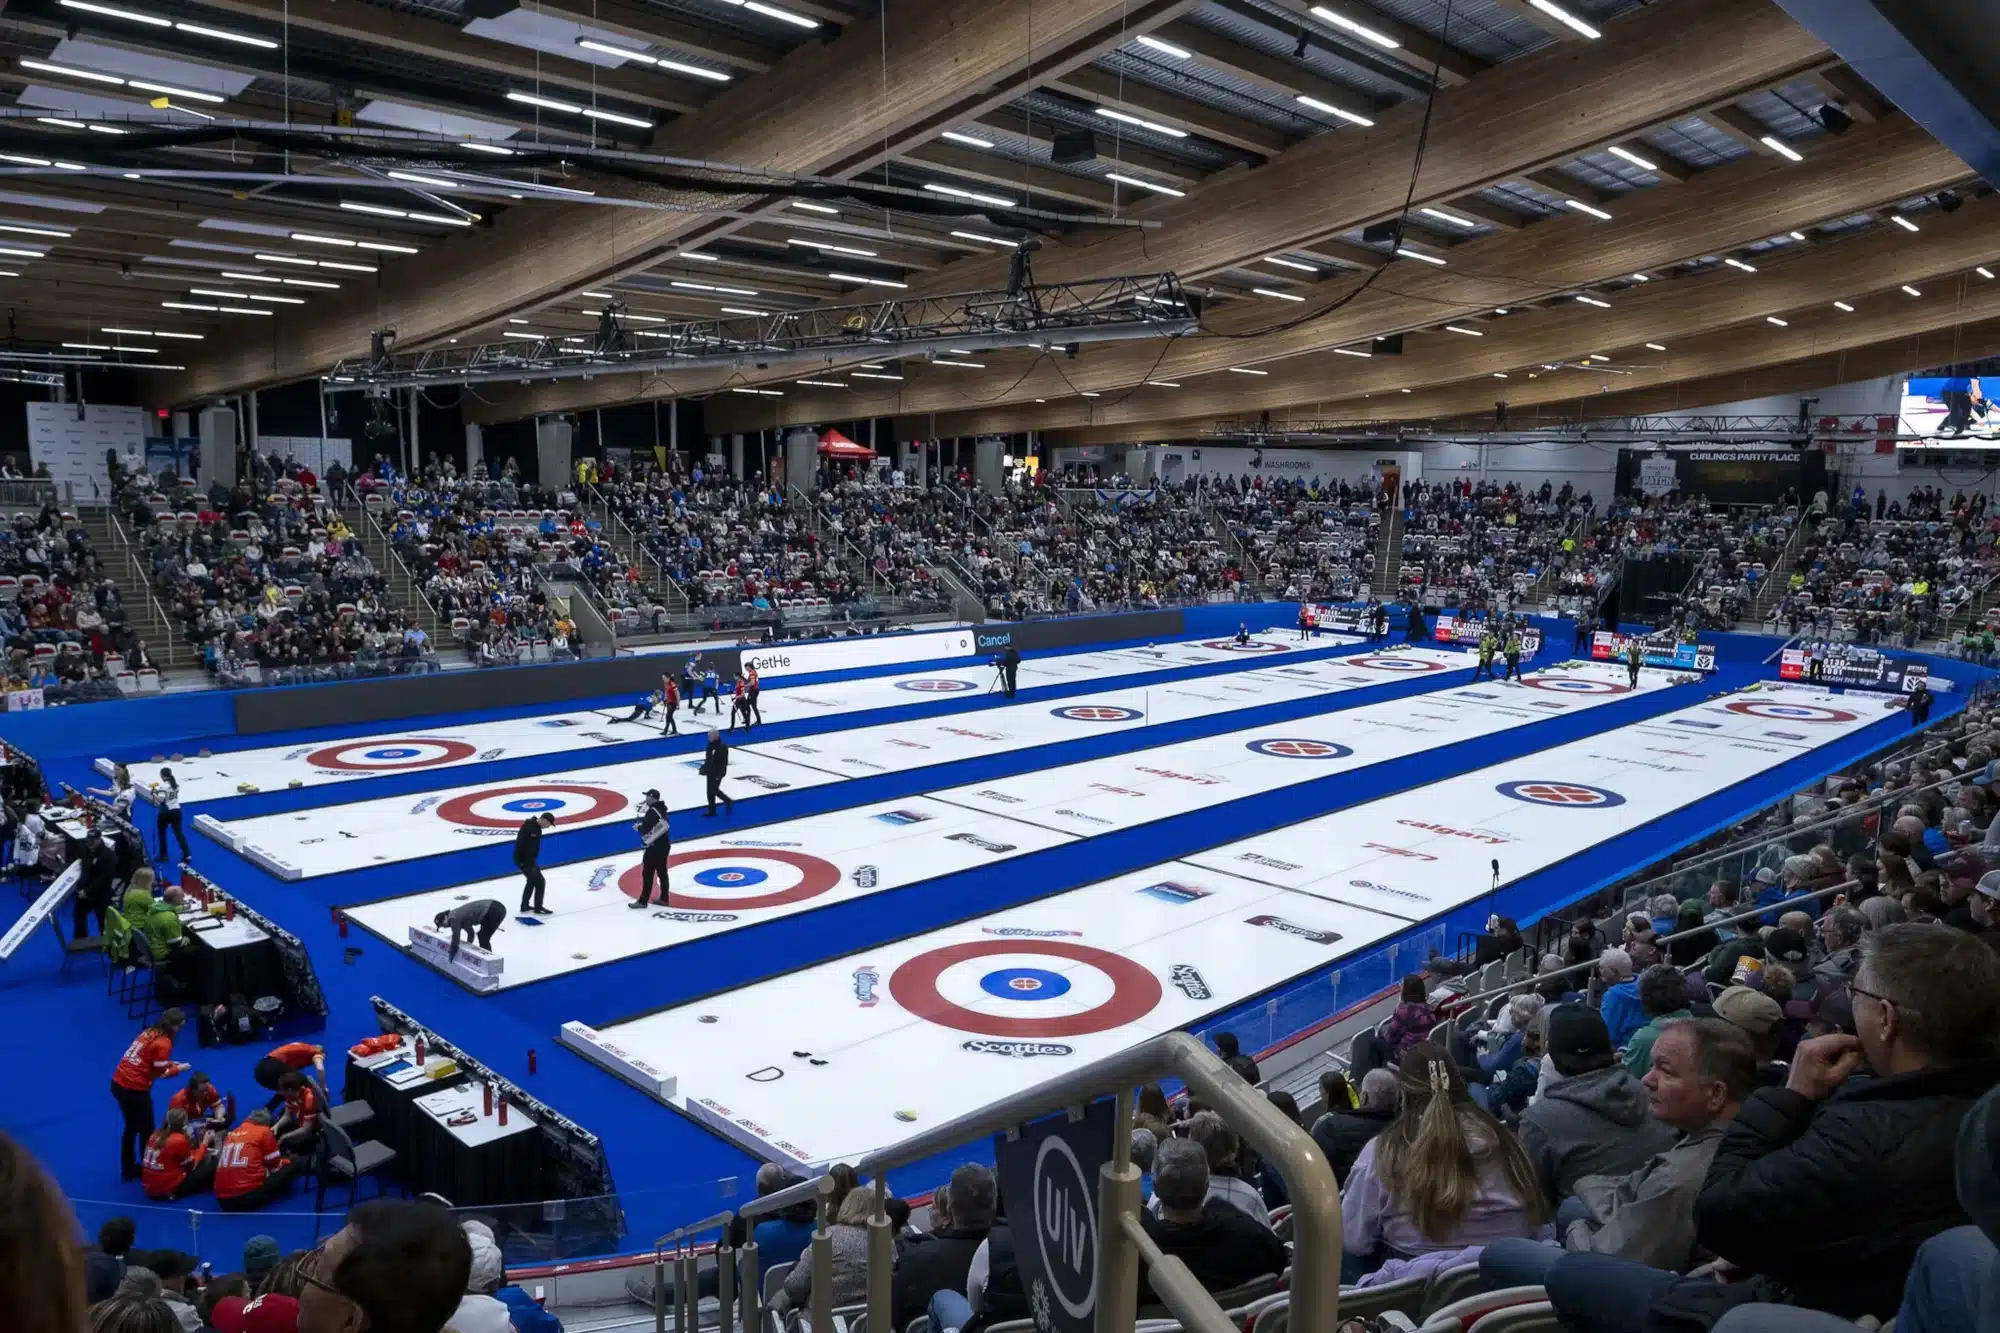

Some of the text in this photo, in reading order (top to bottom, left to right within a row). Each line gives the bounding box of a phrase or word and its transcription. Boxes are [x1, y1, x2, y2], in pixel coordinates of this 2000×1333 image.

[1264, 460, 1311, 469] WASHROOMS
[1690, 452, 1800, 462] CURLING'S PARTY PLACE
[977, 632, 1011, 647] Cancel
[751, 654, 791, 670] GetHe
[1135, 766, 1220, 785] calgary
[1397, 819, 1511, 844] calgary
[964, 1039, 1071, 1057] Scotties
[217, 1142, 249, 1167] NL
